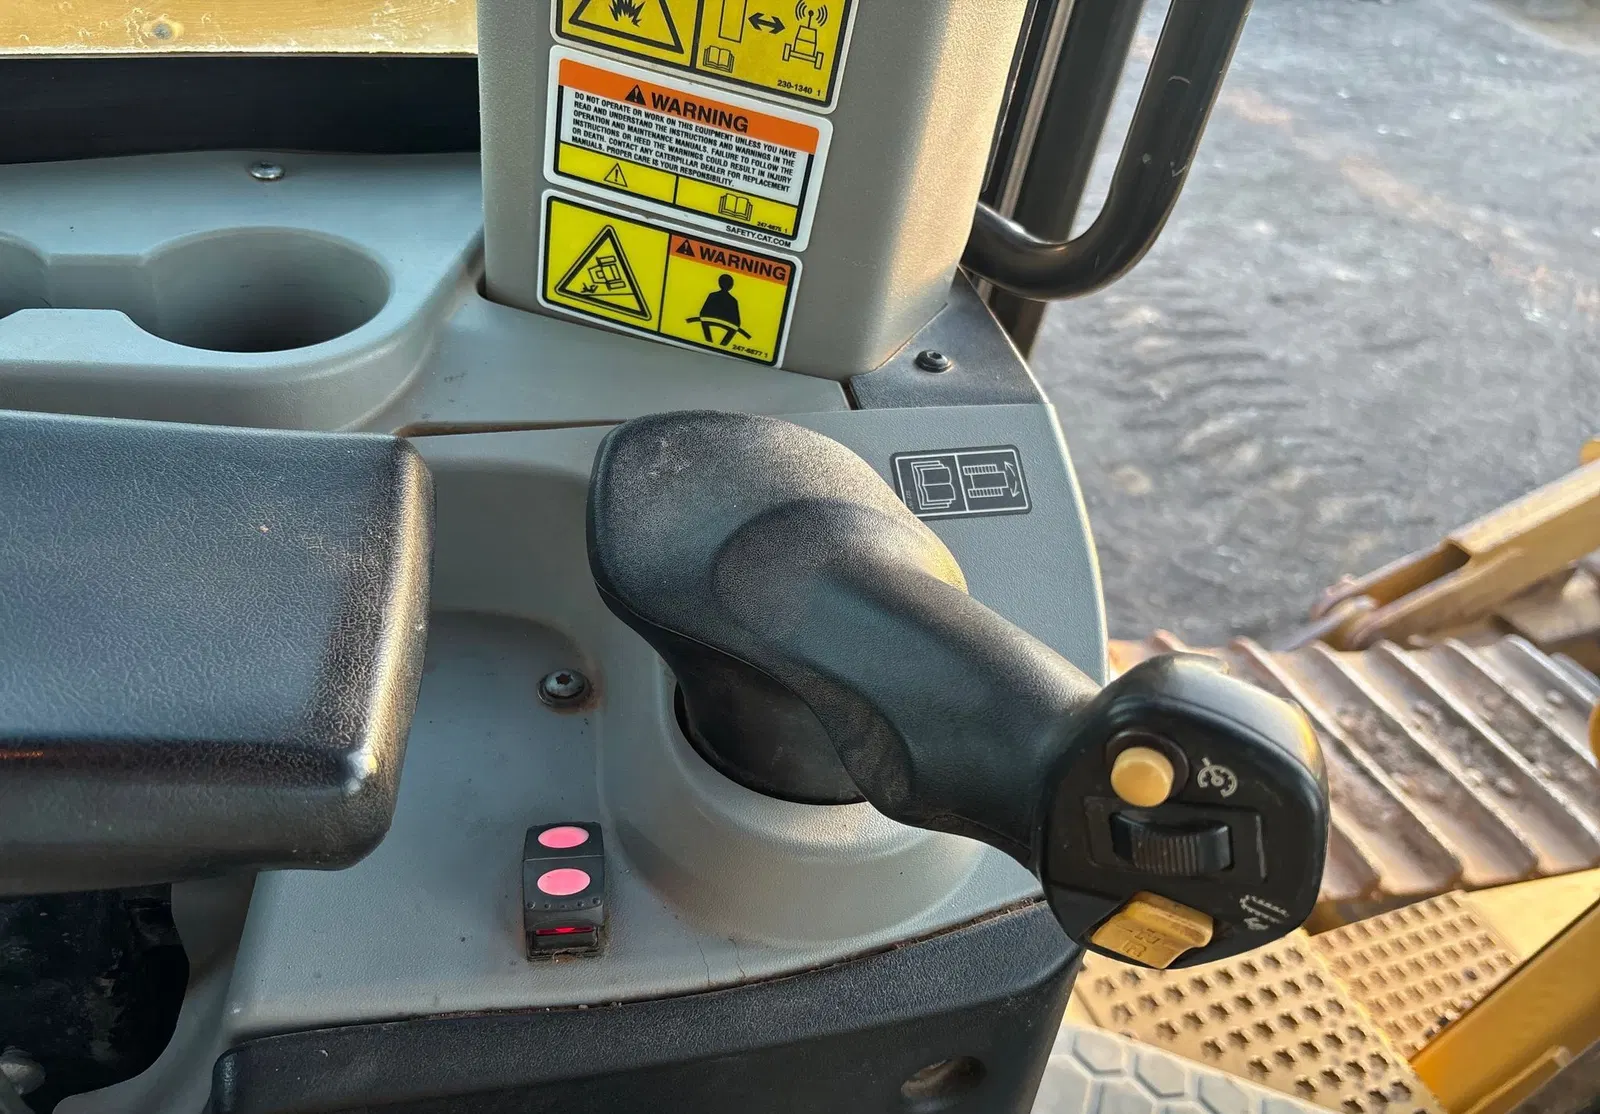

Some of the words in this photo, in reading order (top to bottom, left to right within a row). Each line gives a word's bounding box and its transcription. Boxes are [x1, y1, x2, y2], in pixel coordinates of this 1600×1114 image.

[651, 91, 749, 133] WARNING
[777, 79, 813, 94] 230-1340
[573, 118, 619, 137] INSTRUCTIONS
[622, 132, 631, 140] OR
[634, 135, 650, 145] HEED
[653, 140, 665, 149] THE
[668, 144, 703, 159] WARNINGS
[706, 155, 728, 166] COULD
[730, 161, 755, 173] RESULT
[767, 171, 791, 183] INJURY
[574, 101, 591, 111] READ
[593, 106, 606, 115] AND
[609, 110, 652, 128] UNDERSTAND
[655, 123, 667, 132] THE
[669, 127, 717, 145] INSTRUCTIONS
[719, 140, 733, 150] AND
[735, 145, 771, 160] WARNINGS
[782, 158, 795, 166] THE
[574, 110, 609, 125] OPERATION
[612, 120, 625, 129] AND
[628, 124, 673, 142] MAINTENANCE
[675, 137, 708, 152] MANUALS.
[711, 147, 738, 160] FAILURE
[740, 155, 749, 163] TO
[751, 158, 778, 171] FOLLOW
[780, 166, 793, 175] THE
[575, 92, 583, 100] DO
[586, 95, 599, 104] NOT
[602, 99, 630, 113] OPERATE
[633, 108, 642, 116] OR
[644, 111, 664, 122] WORK
[666, 117, 675, 125] ON
[678, 120, 693, 130] THIS
[695, 125, 733, 141] EQUIPMENT
[735, 136, 761, 148] UNLESS
[763, 144, 777, 153] YOU
[779, 148, 796, 158] HAVE
[572, 127, 581, 135] OR
[584, 130, 606, 142] DEATH.
[609, 137, 638, 151] CONTACT
[640, 146, 653, 155] ANY
[655, 150, 698, 167] CATERPILLAR
[700, 162, 725, 174] DEALER
[727, 169, 741, 178] FOR
[743, 173, 789, 191] REPLACEMENT
[572, 136, 604, 151] MANUALS.
[607, 146, 632, 158] PROPER
[634, 153, 650, 163] CARE
[660, 160, 678, 170] YOUR
[680, 166, 734, 186] RESPONSIBILITY.
[700, 246, 786, 281] WARNING
[725, 225, 792, 248] SAFETY.CAT.COM
